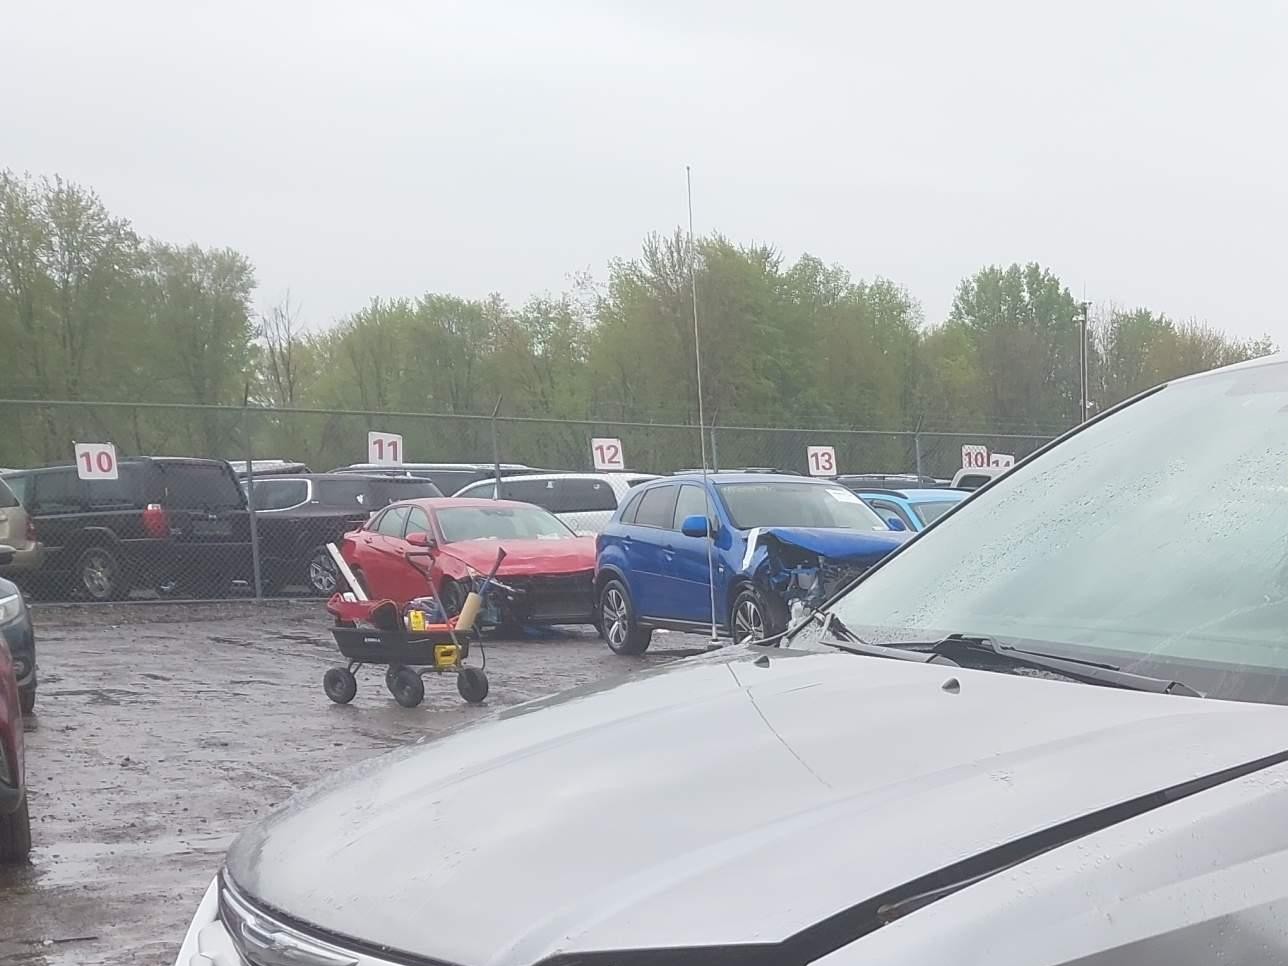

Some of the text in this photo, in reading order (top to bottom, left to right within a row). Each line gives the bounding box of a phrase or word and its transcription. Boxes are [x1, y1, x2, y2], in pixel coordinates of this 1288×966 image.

[373, 438, 399, 461] 11
[594, 444, 619, 464] 12
[965, 452, 984, 467] 10
[80, 451, 113, 473] 10
[811, 451, 833, 471] 13
